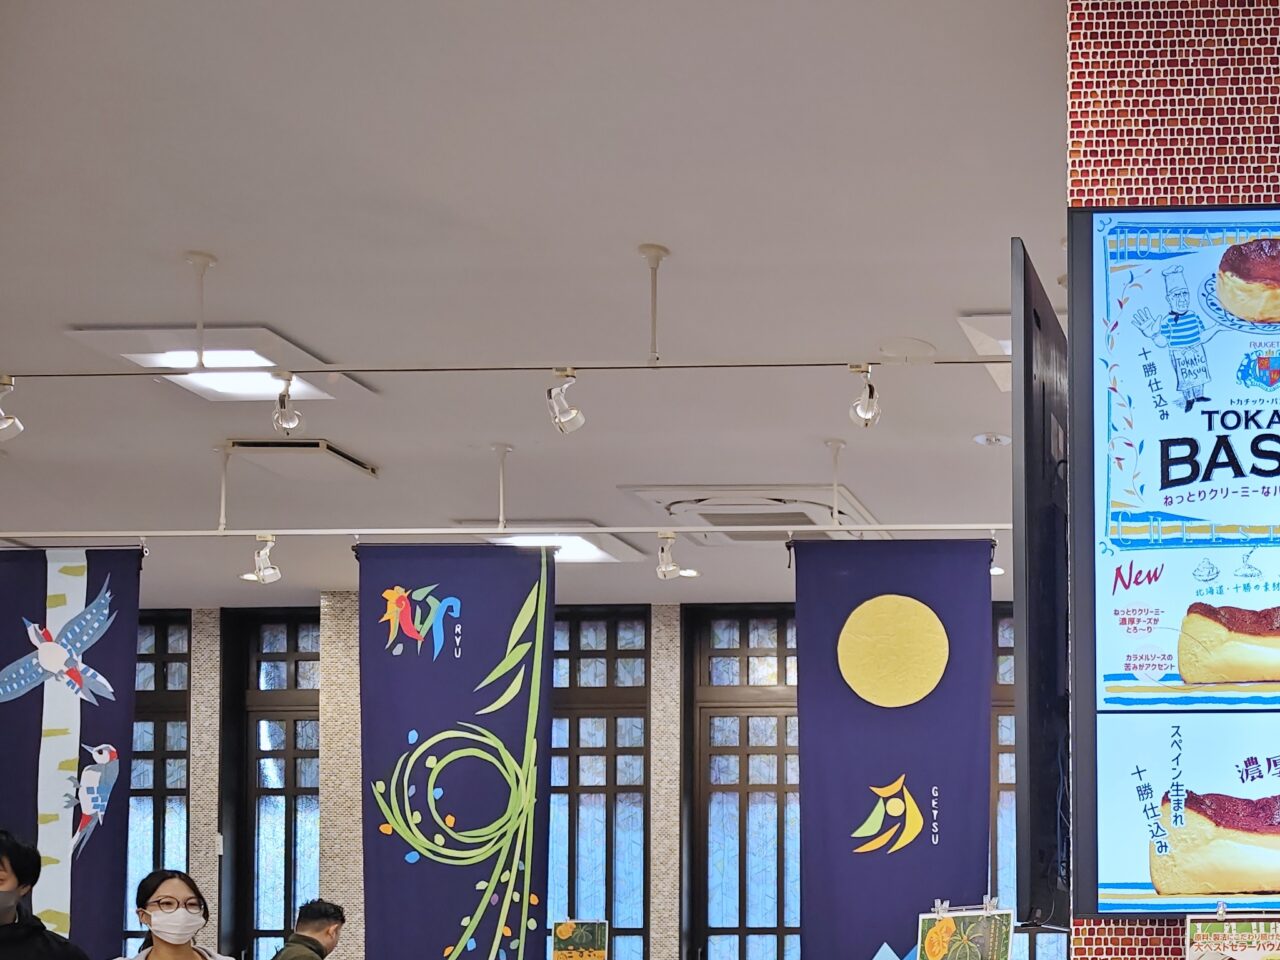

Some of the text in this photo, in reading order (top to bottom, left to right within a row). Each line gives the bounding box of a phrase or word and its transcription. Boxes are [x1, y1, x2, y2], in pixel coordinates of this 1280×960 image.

[1138, 348, 1170, 421] 十勝仕込み
[1112, 560, 1165, 596] New
[1113, 608, 1165, 616] ねっとりクリーミー
[454, 623, 462, 658] RYU
[1124, 663, 1176, 671] 苦みがアクセント
[1170, 724, 1186, 827] スペイン生まれ
[931, 786, 939, 845] GETSU
[1130, 765, 1170, 854] 十勝仕込み
